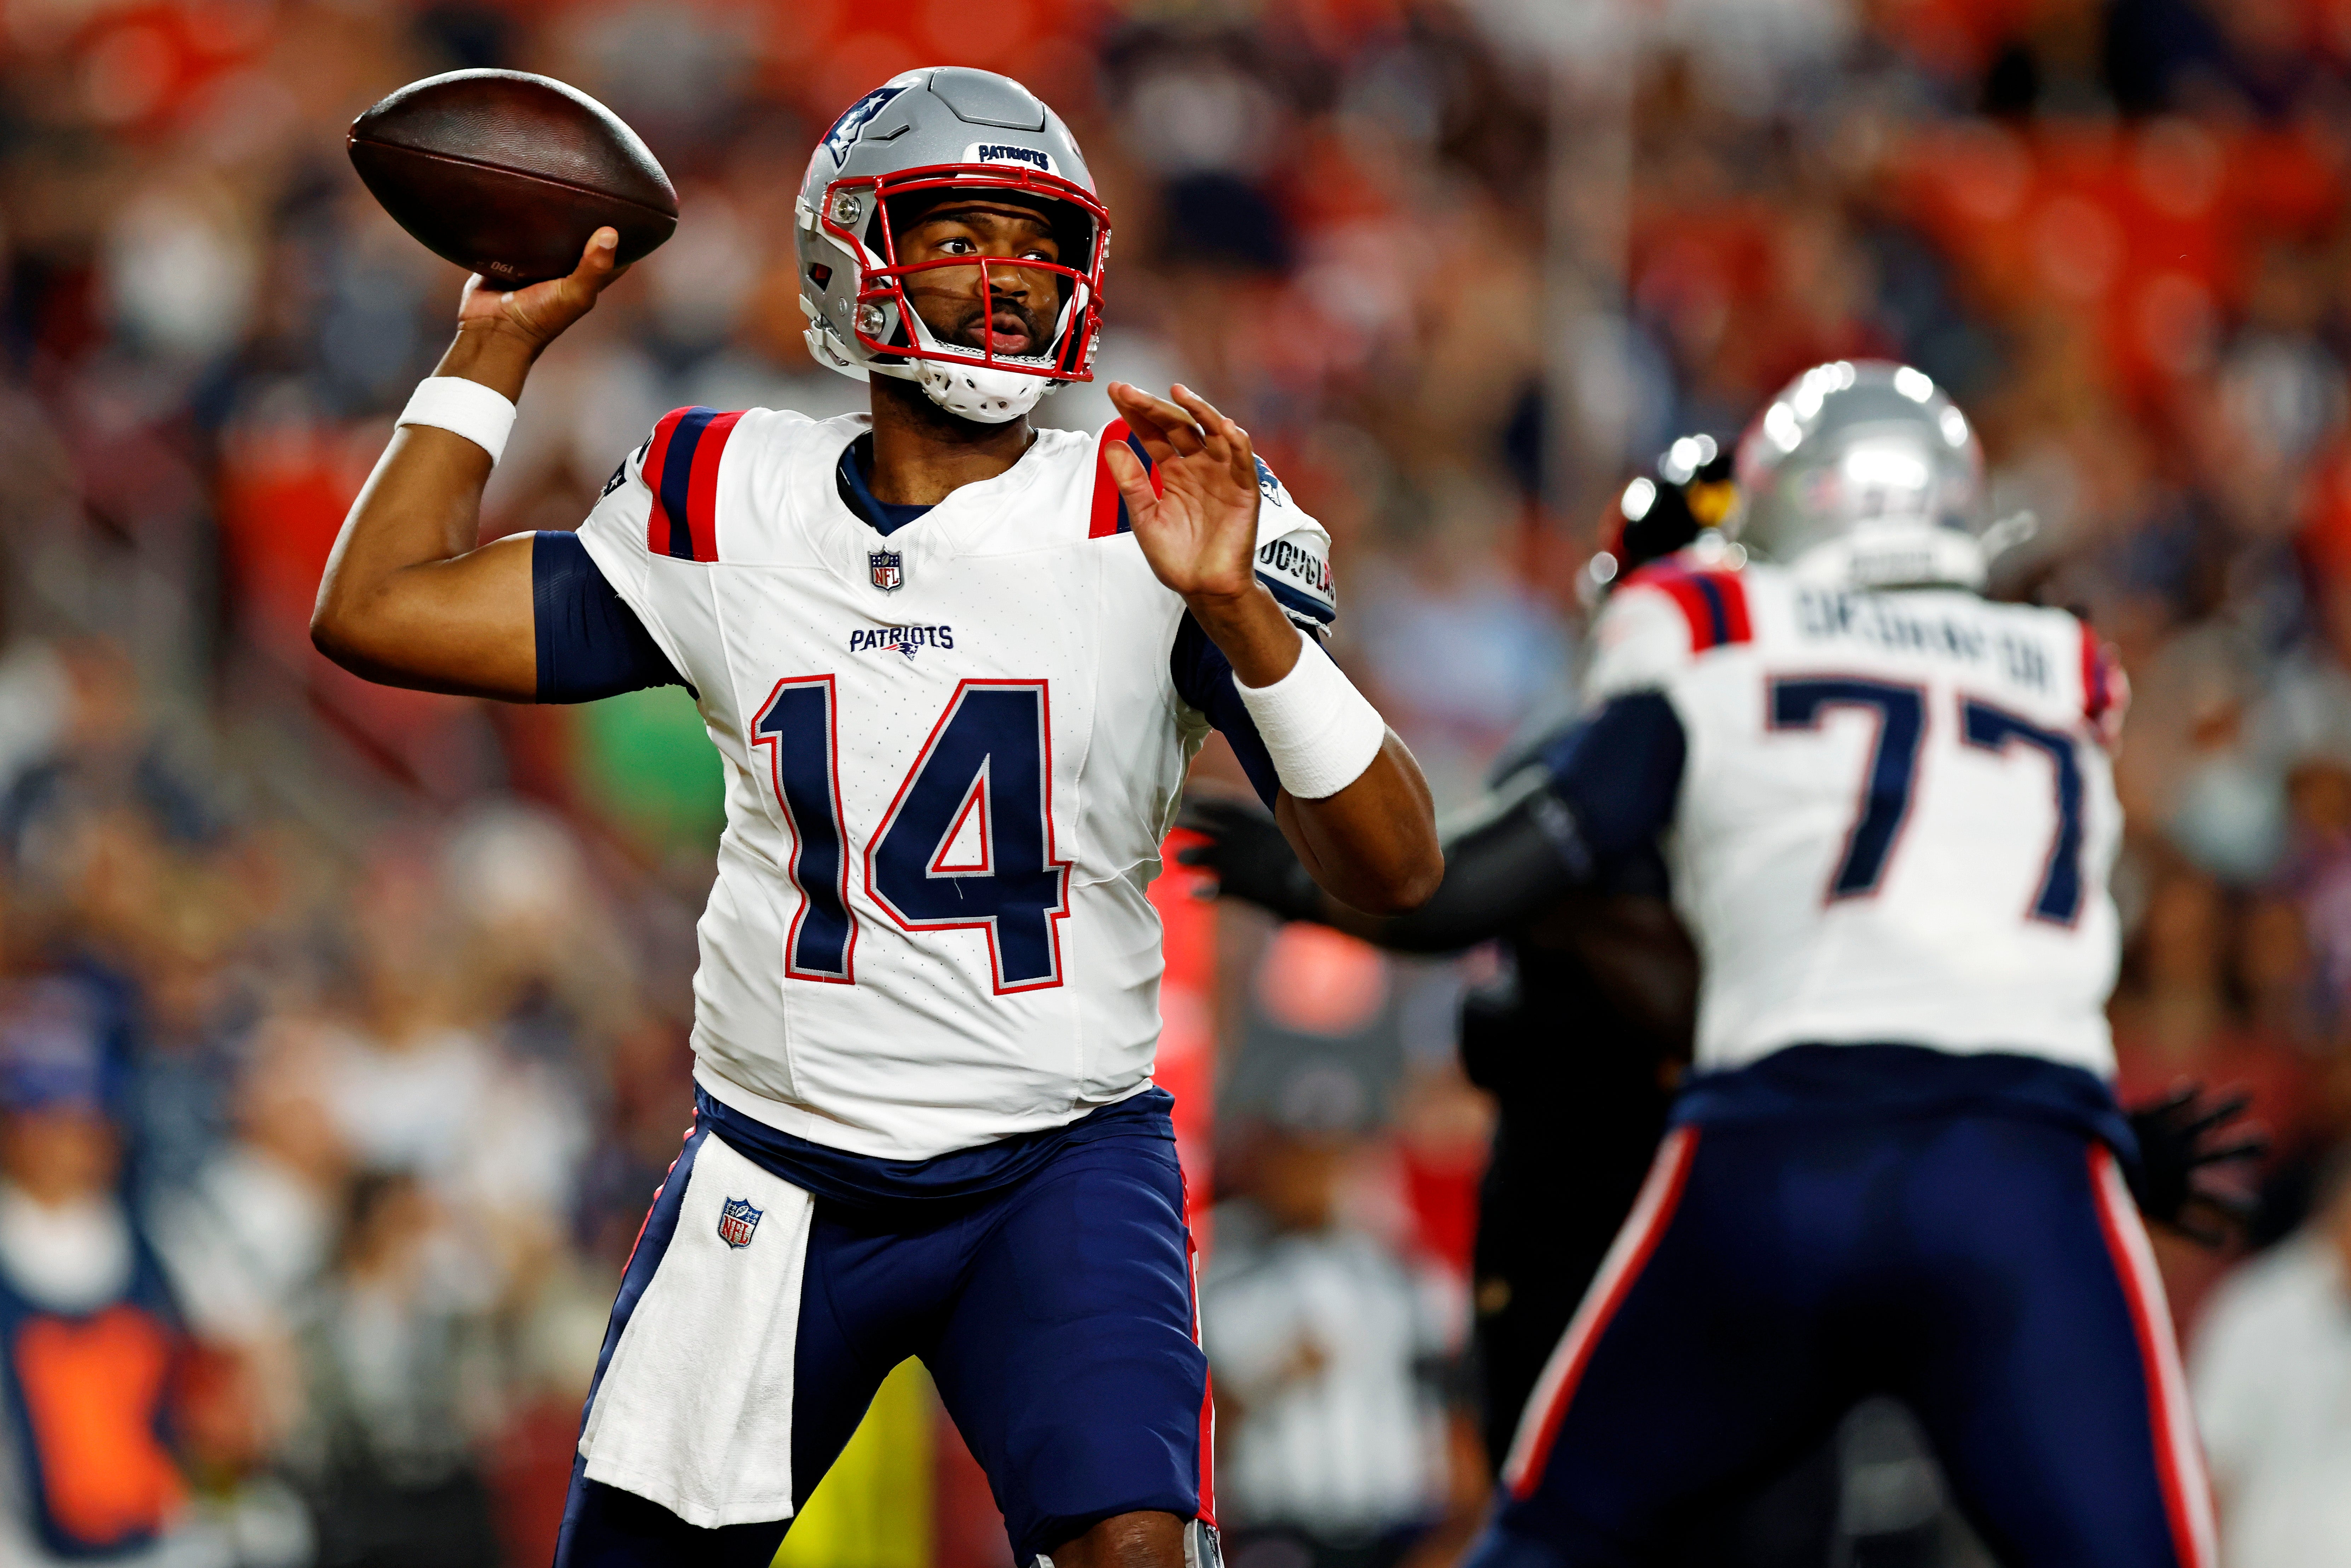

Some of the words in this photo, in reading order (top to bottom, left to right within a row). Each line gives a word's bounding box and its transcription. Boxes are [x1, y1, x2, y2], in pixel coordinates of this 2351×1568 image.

[979, 145, 1049, 171] PATRIOTS
[874, 567, 901, 586] NFL
[850, 625, 954, 653] PATRIOTS
[1765, 670, 2086, 928] 77
[752, 673, 1072, 995] 14
[721, 1215, 749, 1244] NFL
